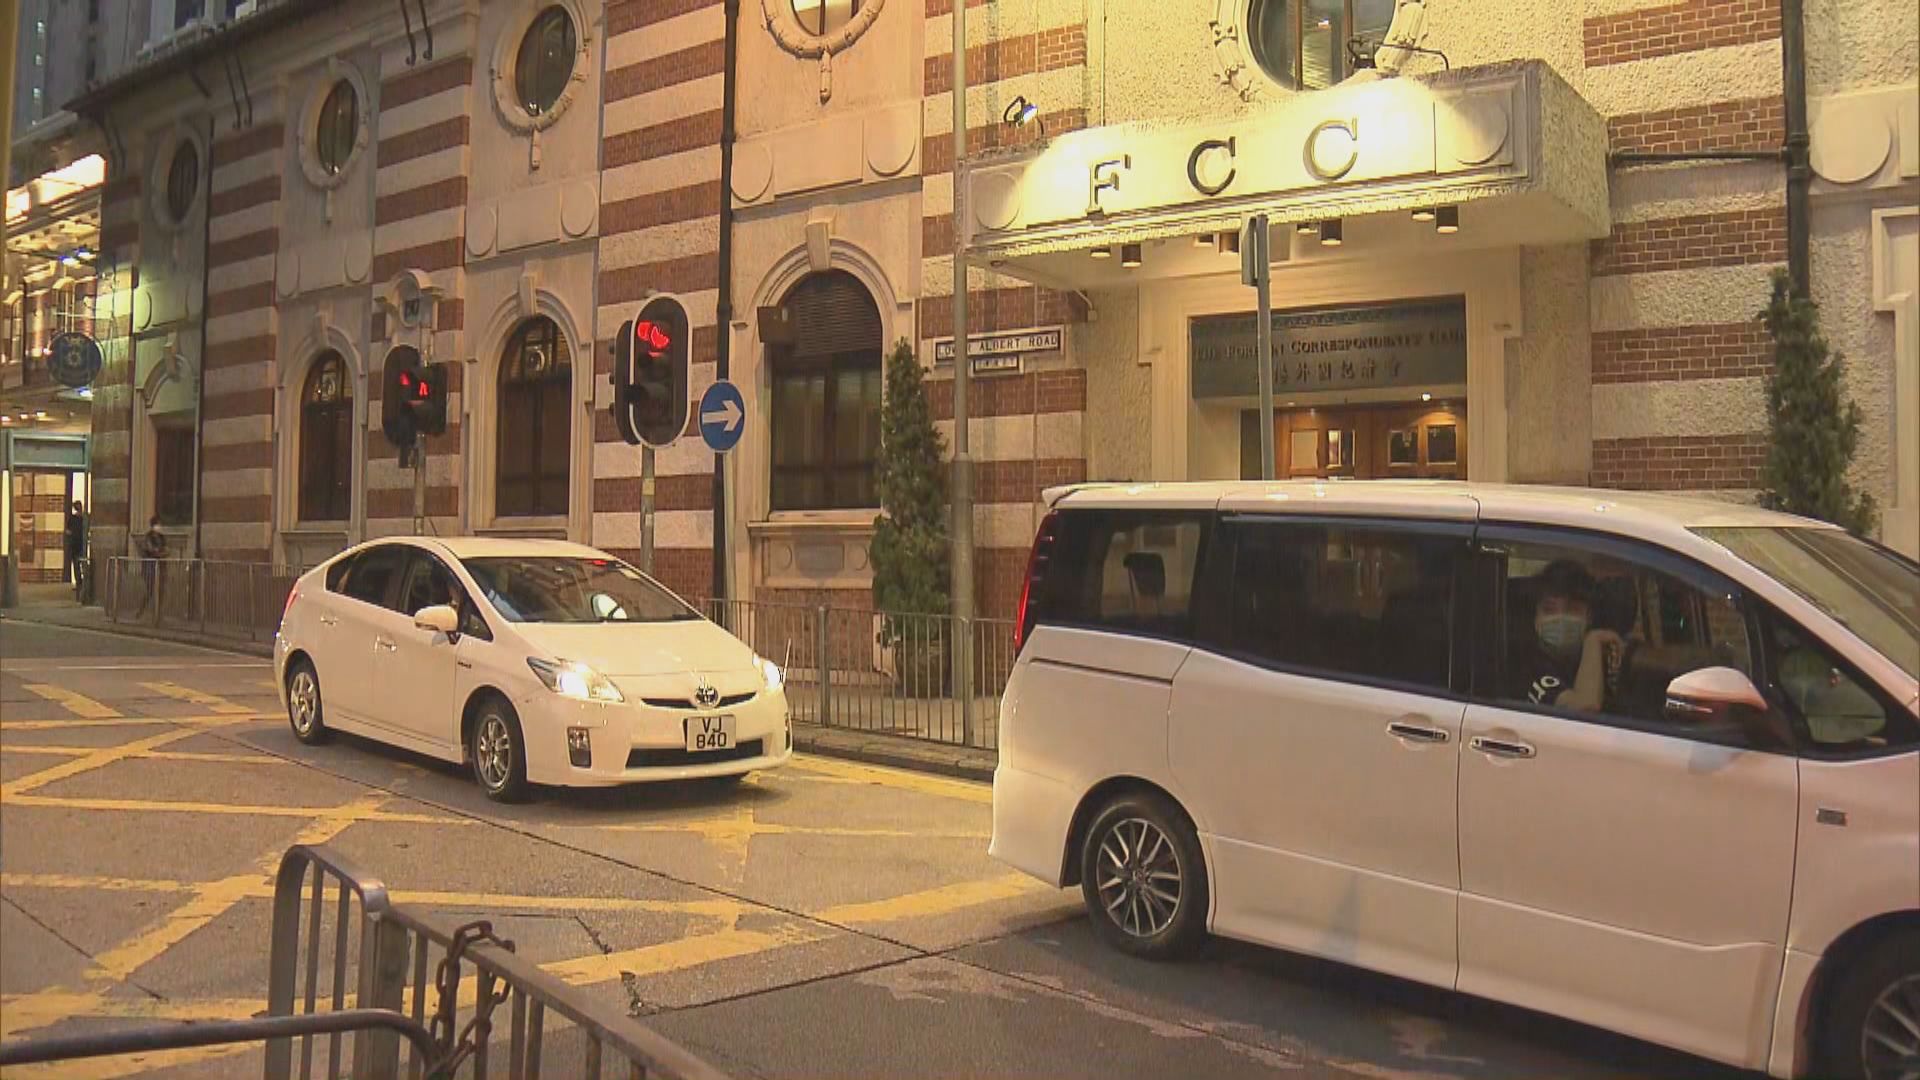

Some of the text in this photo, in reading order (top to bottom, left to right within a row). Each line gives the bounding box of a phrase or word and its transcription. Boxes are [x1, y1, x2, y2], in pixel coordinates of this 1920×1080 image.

[1029, 334, 1057, 347] ROAD
[702, 716, 722, 733] VJ
[696, 732, 727, 749] 840
